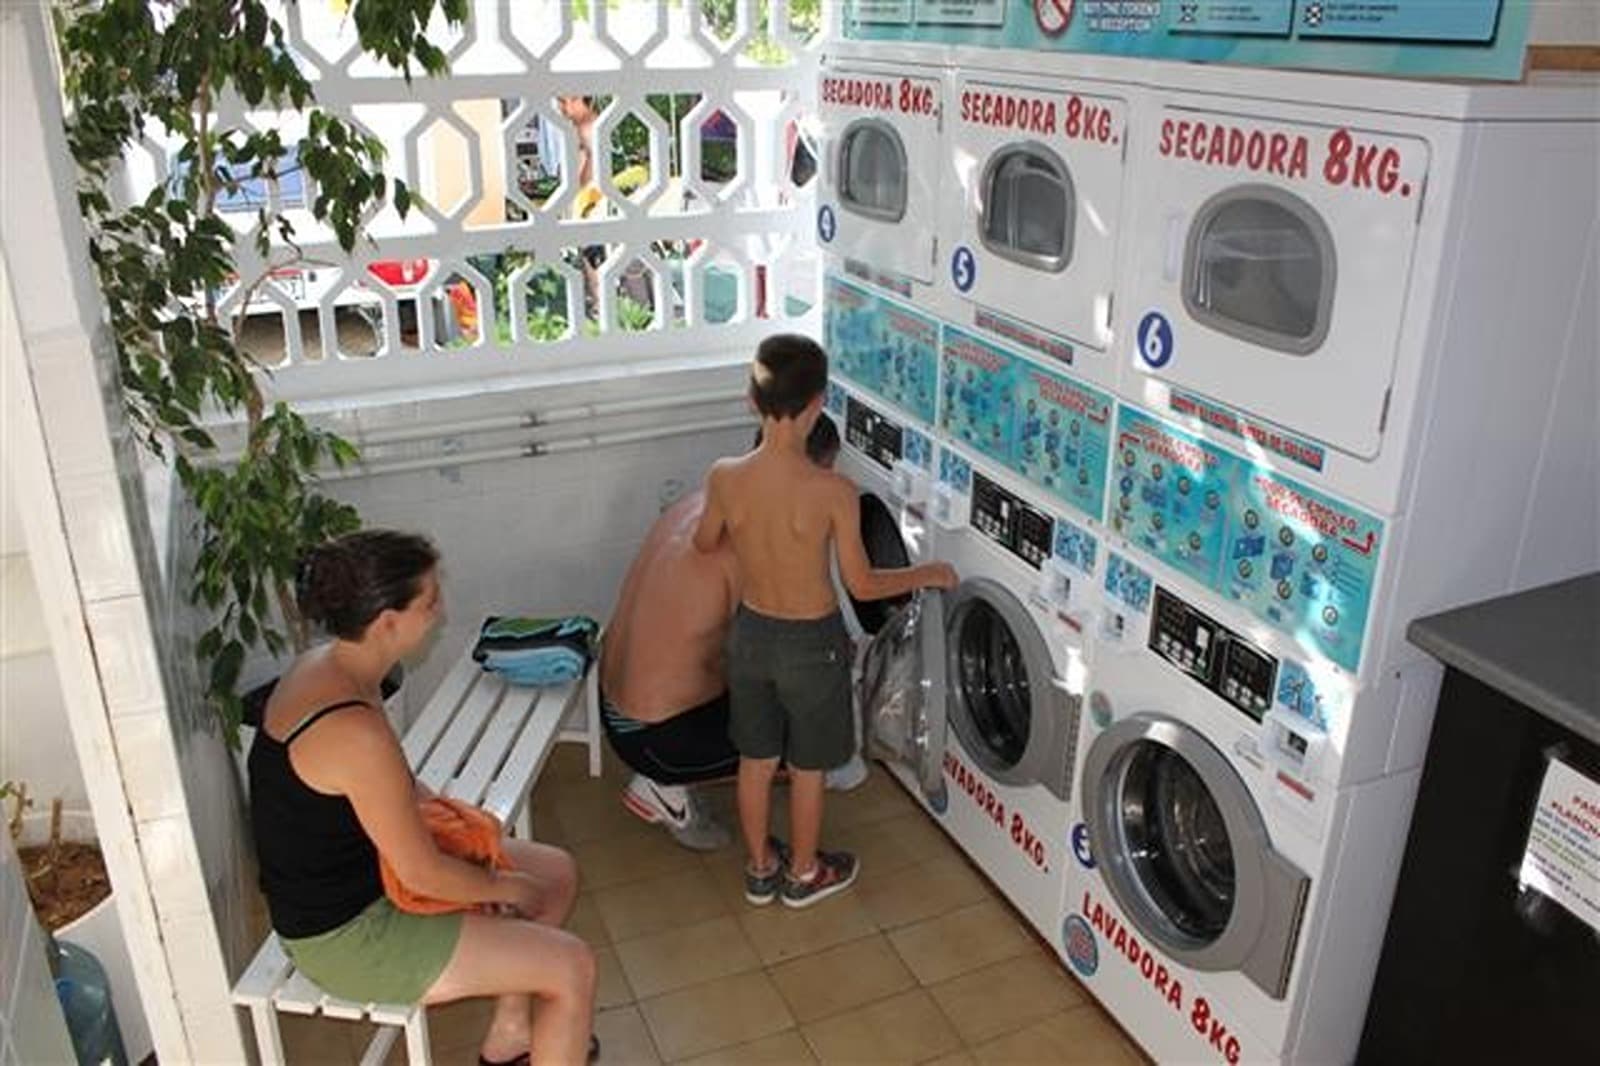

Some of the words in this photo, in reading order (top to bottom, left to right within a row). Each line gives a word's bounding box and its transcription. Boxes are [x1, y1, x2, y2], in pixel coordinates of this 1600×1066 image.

[822, 78, 893, 109] SECADORA
[899, 79, 940, 117] 8KG.
[961, 91, 1058, 135] SECADORA
[1065, 96, 1120, 145] 8KG.
[1159, 118, 1310, 179] SECADORA
[1322, 127, 1412, 198] 8KG.
[821, 208, 832, 240] 4
[957, 251, 969, 287] 5
[1144, 318, 1163, 361] 6
[1010, 812, 1048, 873] 8KG.
[1082, 891, 1183, 1011] LAVADORA
[1190, 997, 1241, 1065] 8KG
